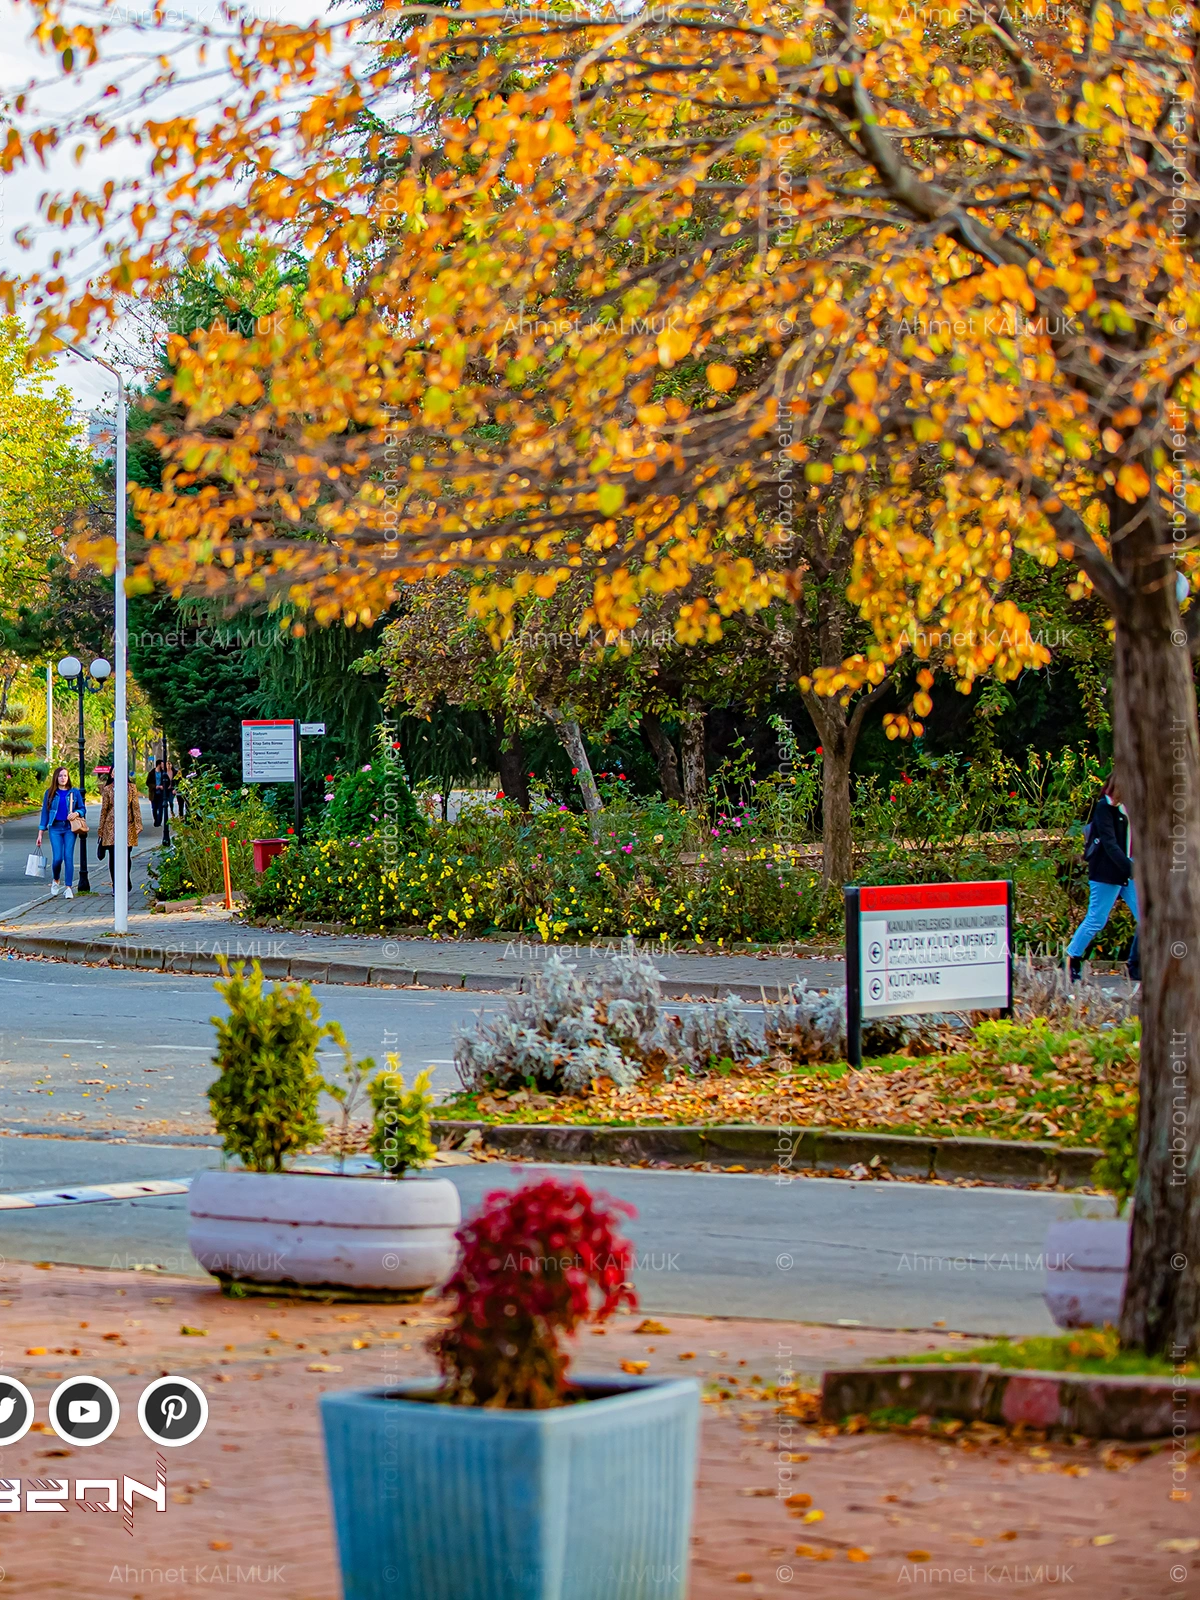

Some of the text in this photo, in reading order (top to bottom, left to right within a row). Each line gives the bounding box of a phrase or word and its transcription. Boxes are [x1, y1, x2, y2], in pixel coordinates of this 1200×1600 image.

[889, 936, 925, 950] ATATÜRK
[928, 933, 960, 949] KÜLTÜR
[888, 970, 940, 986] KÜTÜPHANE
